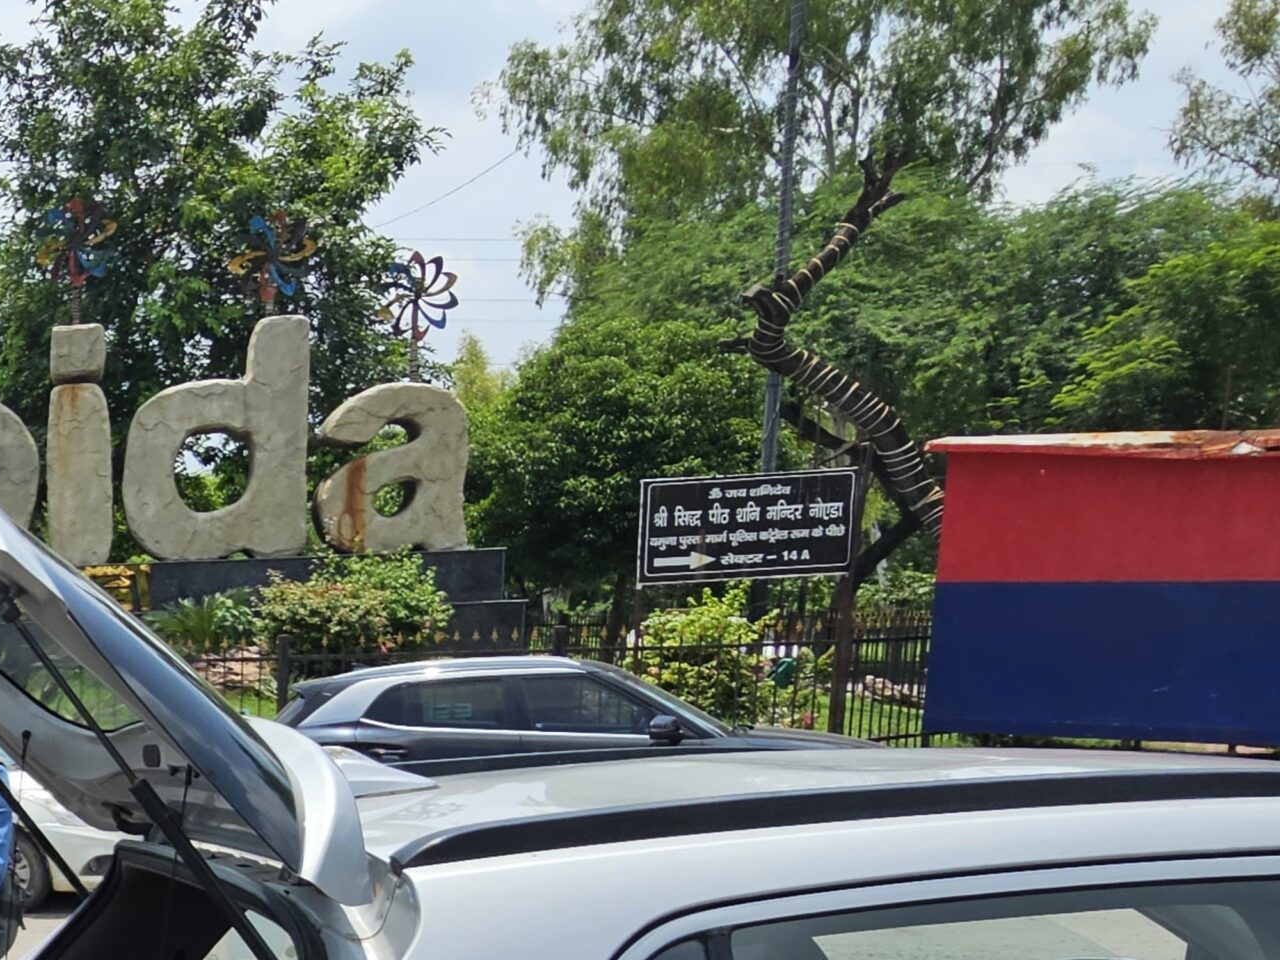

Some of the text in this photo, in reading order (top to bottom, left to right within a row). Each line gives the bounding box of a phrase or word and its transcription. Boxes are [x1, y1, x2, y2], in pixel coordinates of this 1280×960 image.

[725, 488, 747, 498] जय
[749, 484, 792, 497] शनिदेव
[654, 497, 844, 527] श्री सिद्ध पीठ शनि मन्दिर नोएडा
[705, 529, 728, 543] मार्ग
[811, 525, 824, 537] के
[720, 552, 764, 565] सेक्टर
[782, 550, 797, 561] 14
[800, 549, 810, 560] A
